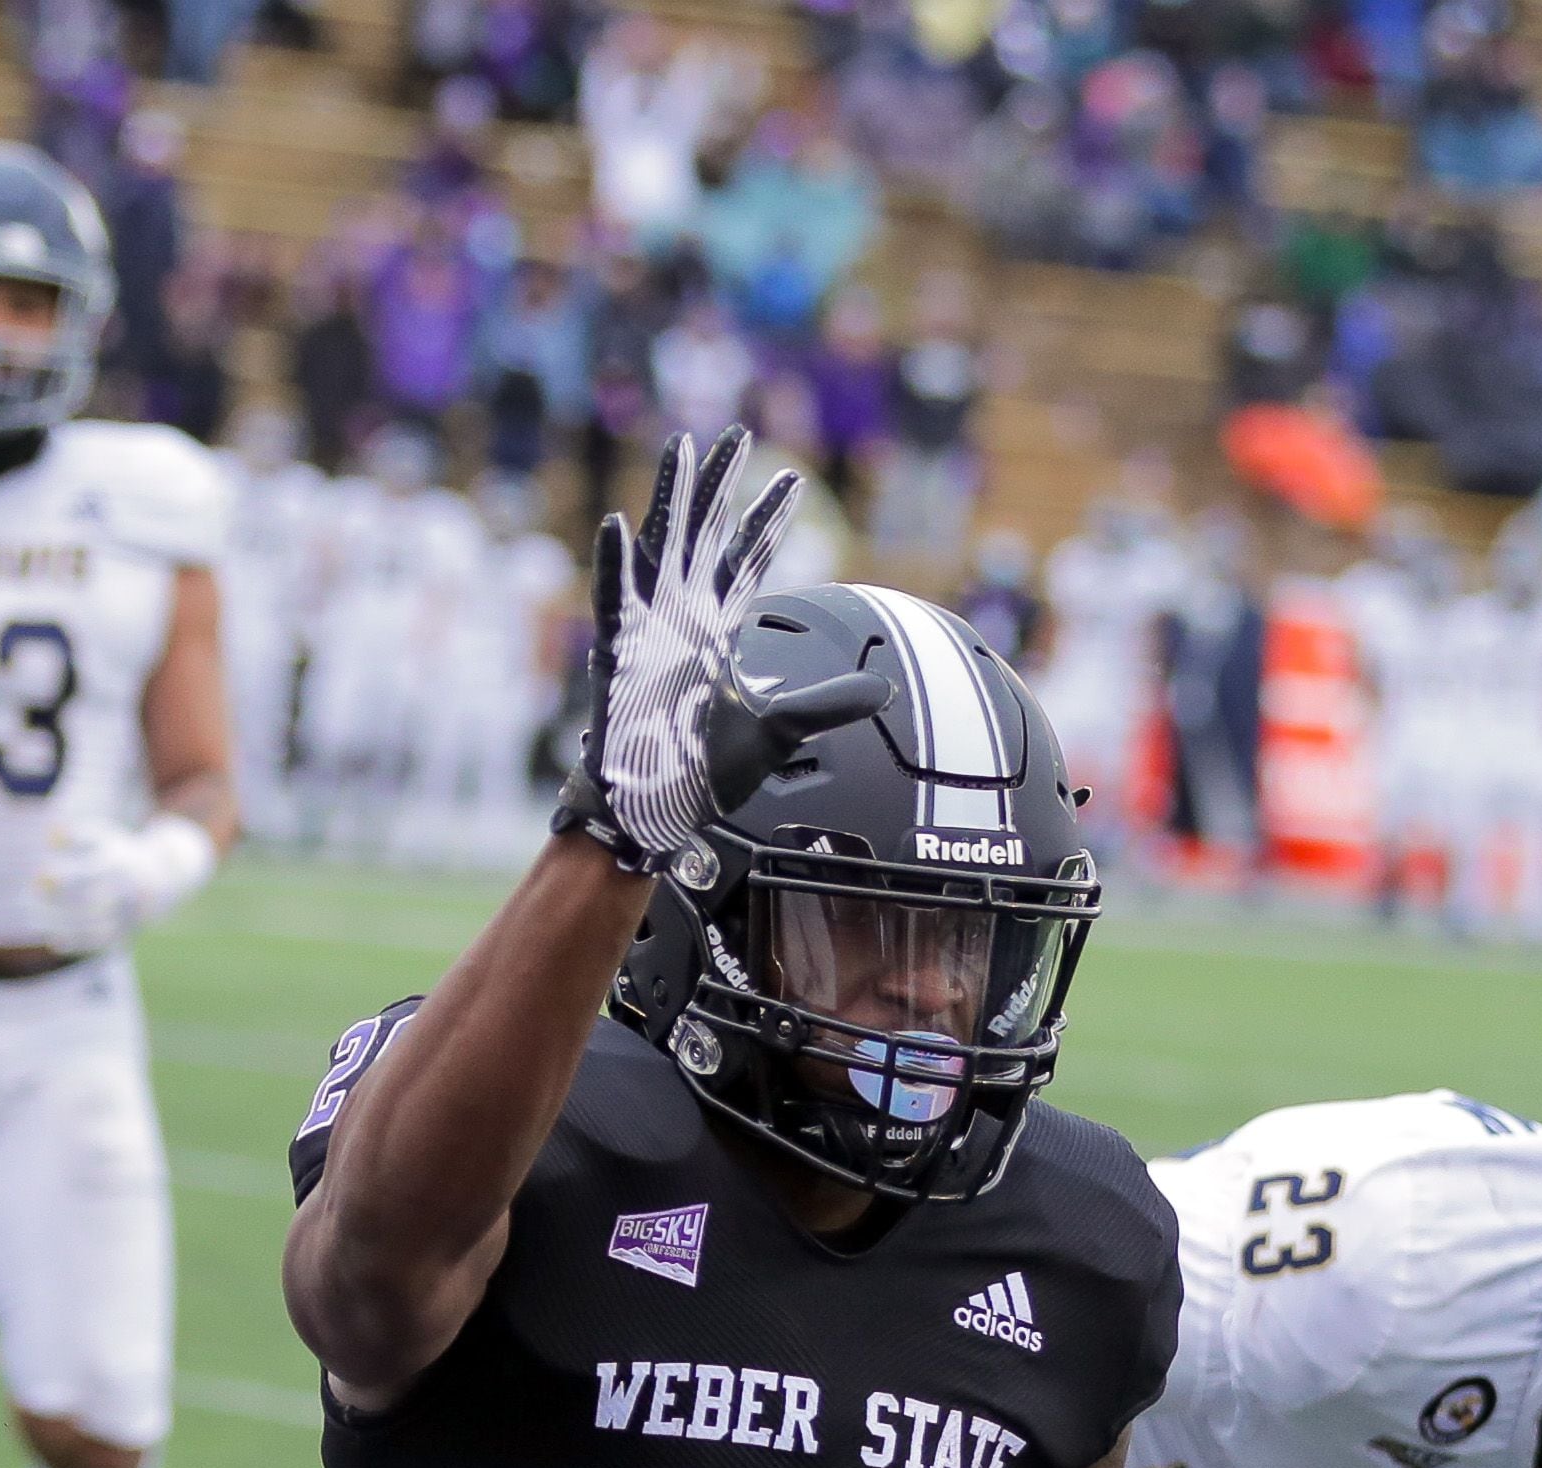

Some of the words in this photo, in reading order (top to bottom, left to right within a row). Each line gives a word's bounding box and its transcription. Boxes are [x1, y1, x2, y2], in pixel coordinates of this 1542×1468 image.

[915, 833, 1024, 865] Riddell
[295, 1015, 417, 1142] 2
[867, 1124, 923, 1140] Rddell
[1241, 1167, 1348, 1278] 23
[953, 1307, 1043, 1352] adidas
[595, 1361, 820, 1454] WEBER
